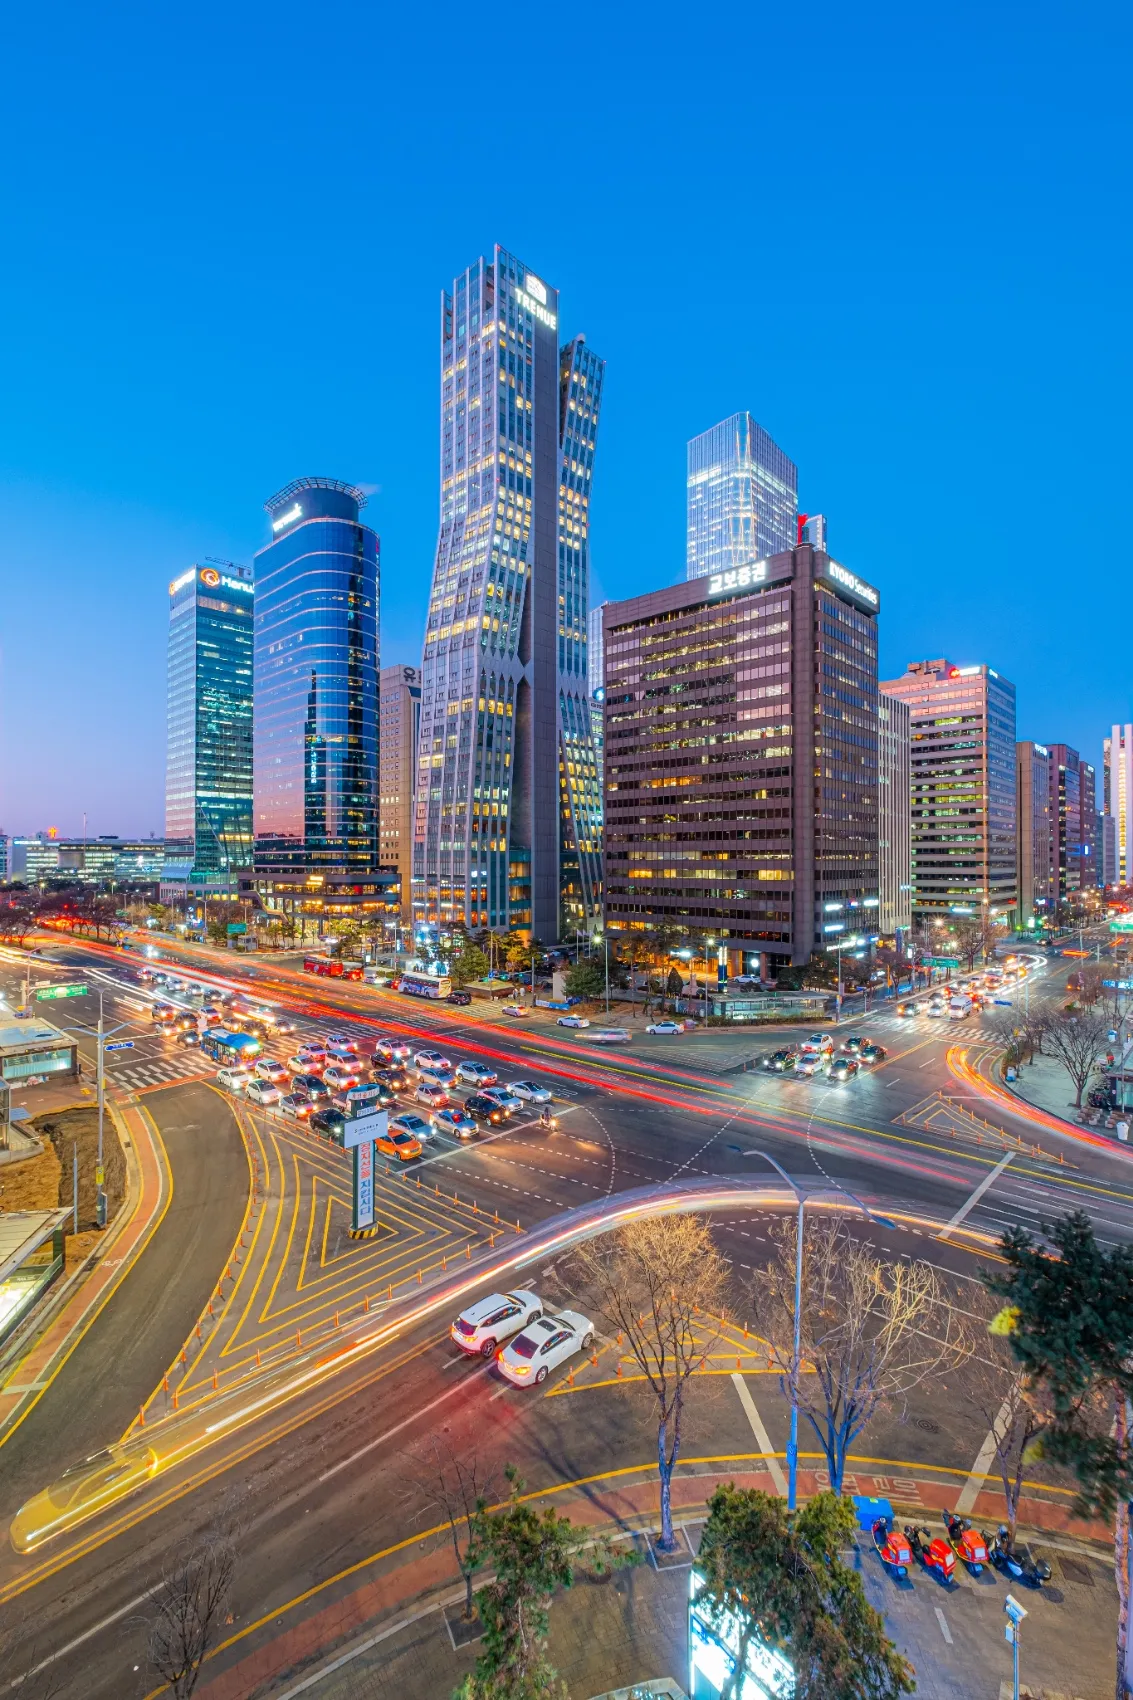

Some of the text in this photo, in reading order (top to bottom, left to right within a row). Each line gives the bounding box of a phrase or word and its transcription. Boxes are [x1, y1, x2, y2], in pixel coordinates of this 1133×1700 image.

[515, 287, 557, 331] TRENUE
[708, 560, 767, 595] 교보증권
[829, 561, 854, 590] KYOBO
